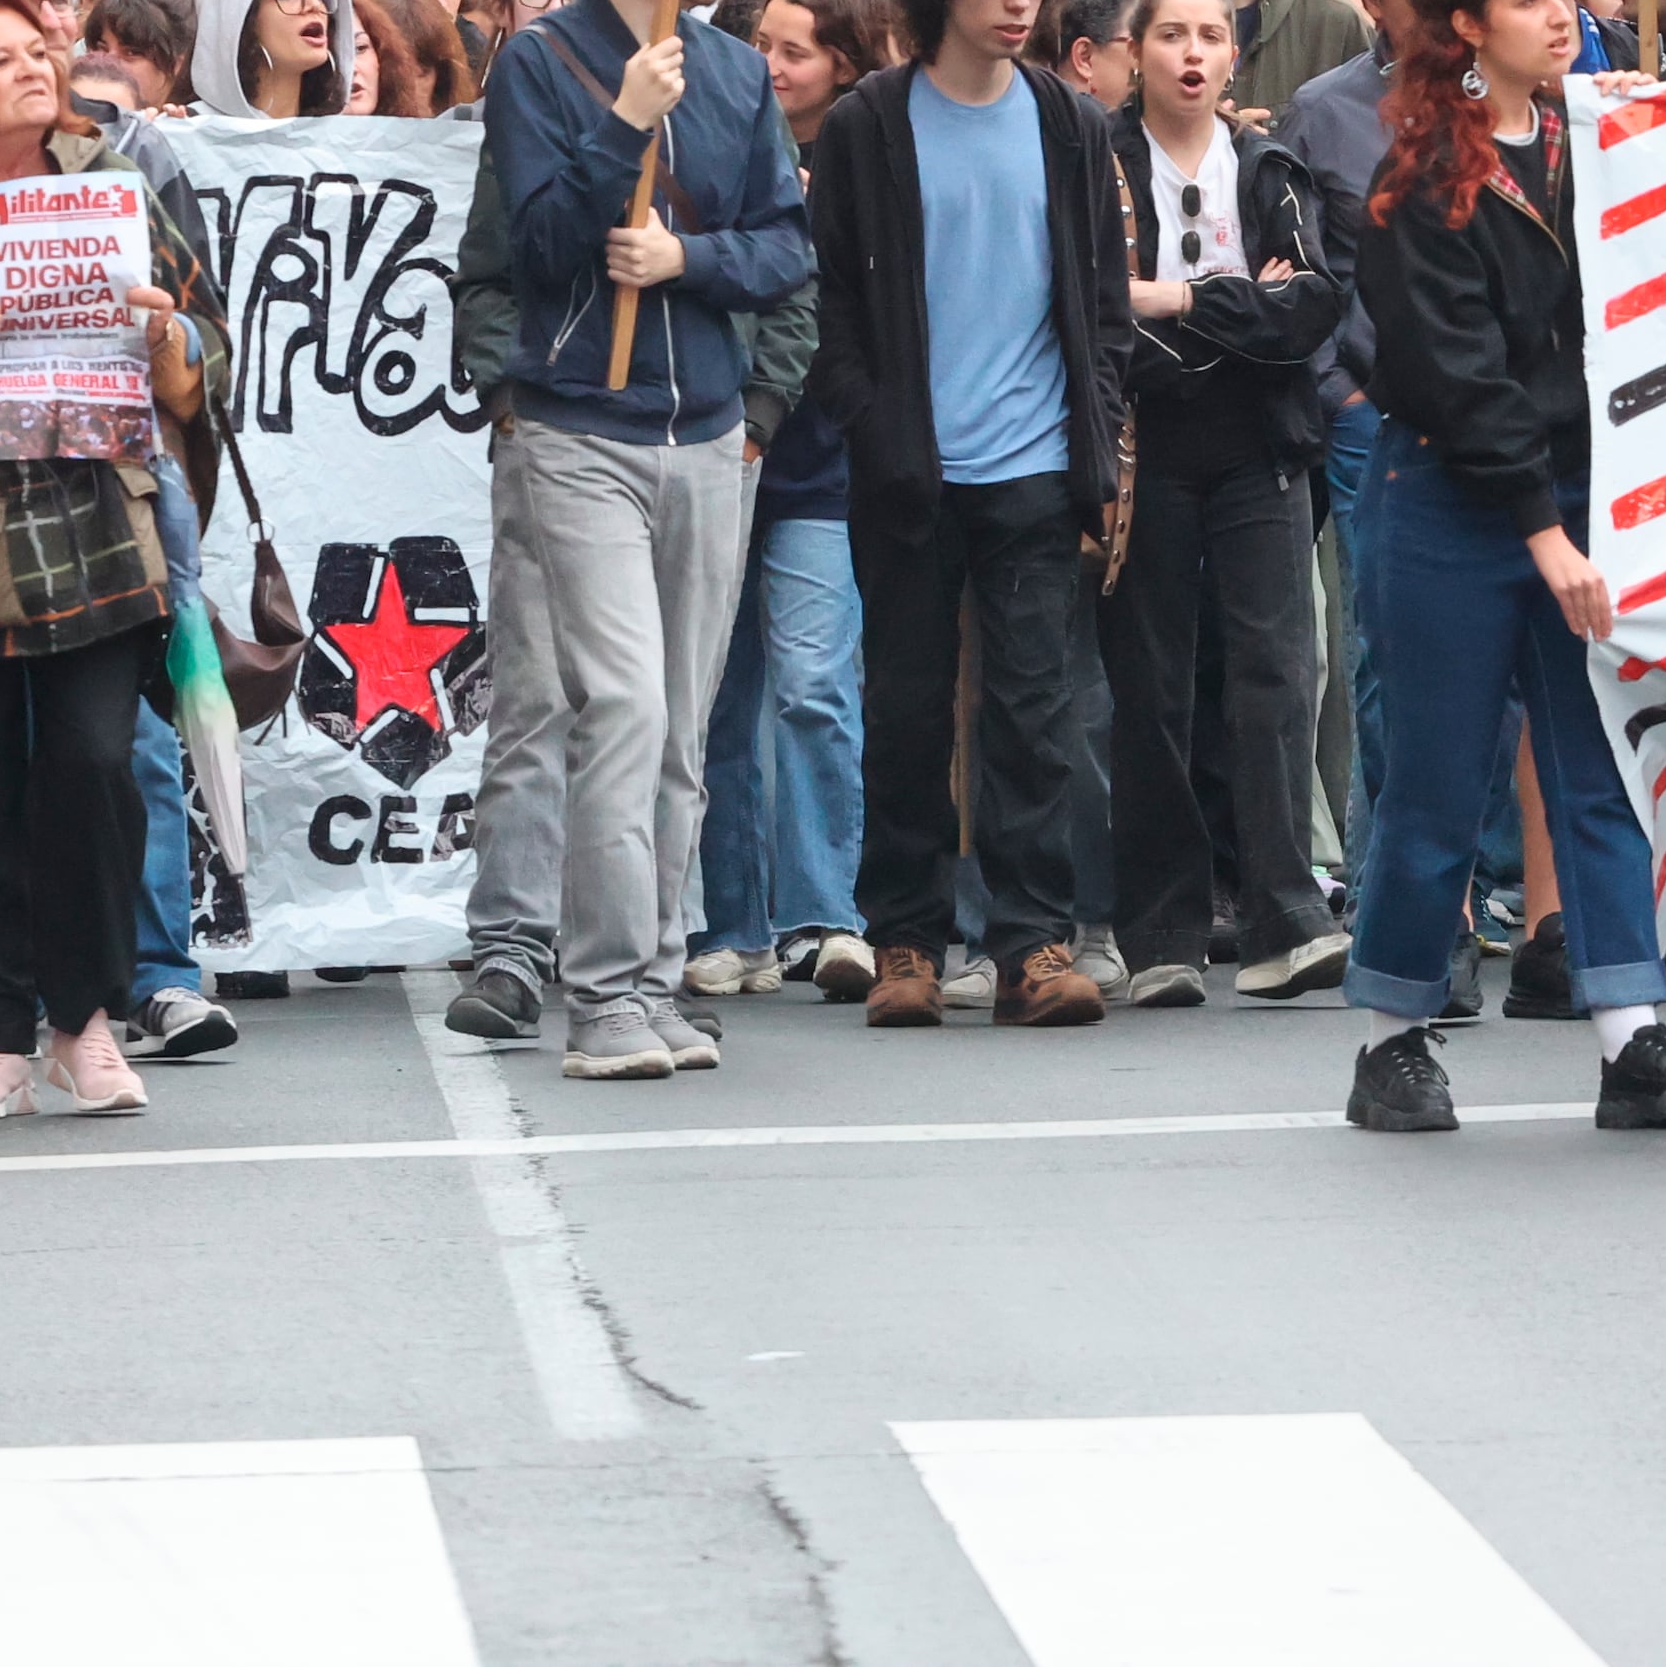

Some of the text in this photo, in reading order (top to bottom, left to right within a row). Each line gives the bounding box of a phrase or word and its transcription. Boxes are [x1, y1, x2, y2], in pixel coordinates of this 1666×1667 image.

[5, 262, 108, 289] DIGNA
[0, 287, 114, 314] PÚBLICA
[53, 373, 120, 389] GENERAL
